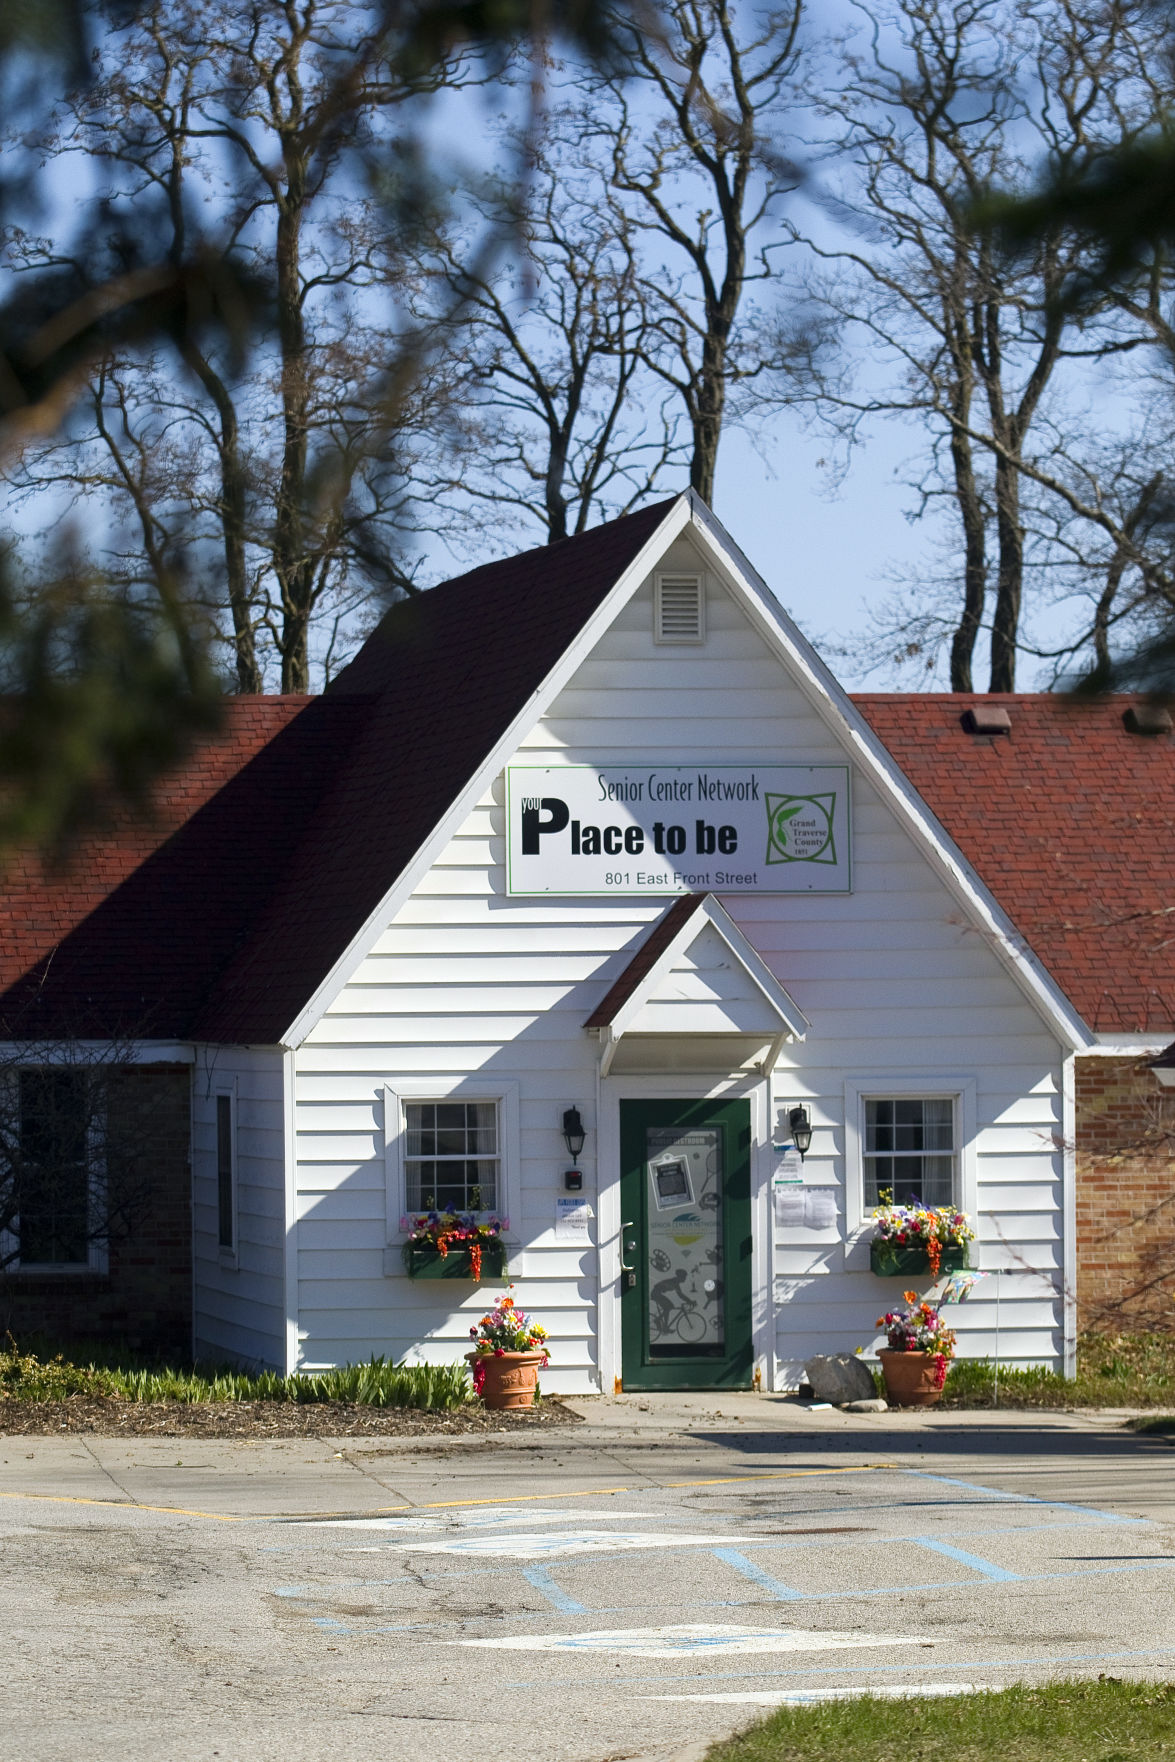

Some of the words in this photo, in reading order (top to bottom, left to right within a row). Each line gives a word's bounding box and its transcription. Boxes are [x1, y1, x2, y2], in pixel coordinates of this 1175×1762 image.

[598, 774, 644, 801] Senior
[648, 774, 693, 801] Center
[698, 774, 759, 801] Network
[522, 798, 644, 855] Place
[652, 822, 686, 855] to
[696, 820, 738, 855] be
[789, 819, 816, 827] Grand
[793, 829, 827, 837] Traverse
[794, 838, 823, 848] County
[605, 872, 630, 884] 801
[637, 872, 668, 884] East
[673, 872, 710, 884] Front
[715, 871, 758, 884] Street
